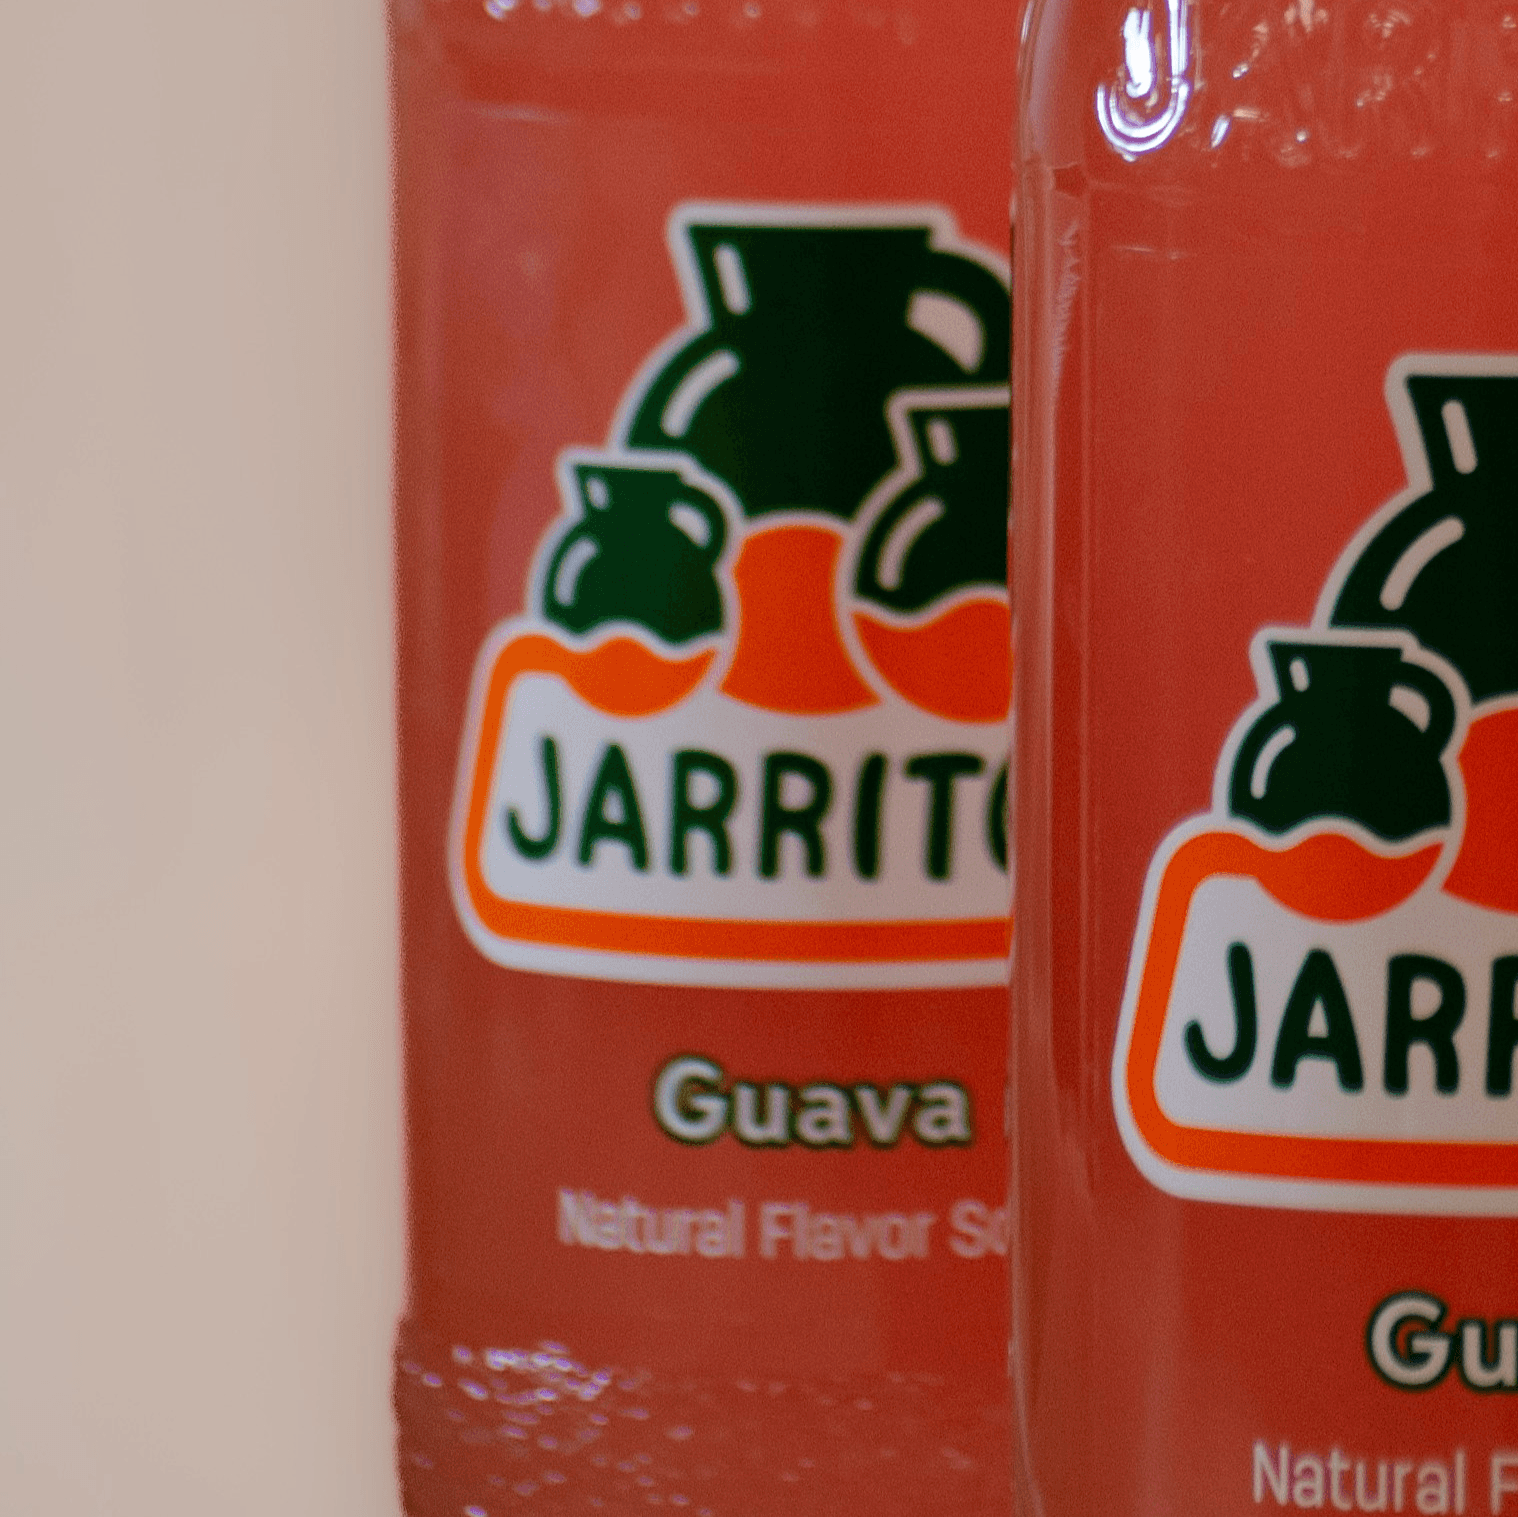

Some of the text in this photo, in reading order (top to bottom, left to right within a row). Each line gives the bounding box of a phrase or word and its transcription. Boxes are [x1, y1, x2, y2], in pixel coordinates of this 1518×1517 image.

[653, 1054, 976, 1149] Guava
[556, 1186, 746, 1259] Natural
[759, 1199, 935, 1260] Flavor
[1252, 1439, 1469, 1515] Natural
